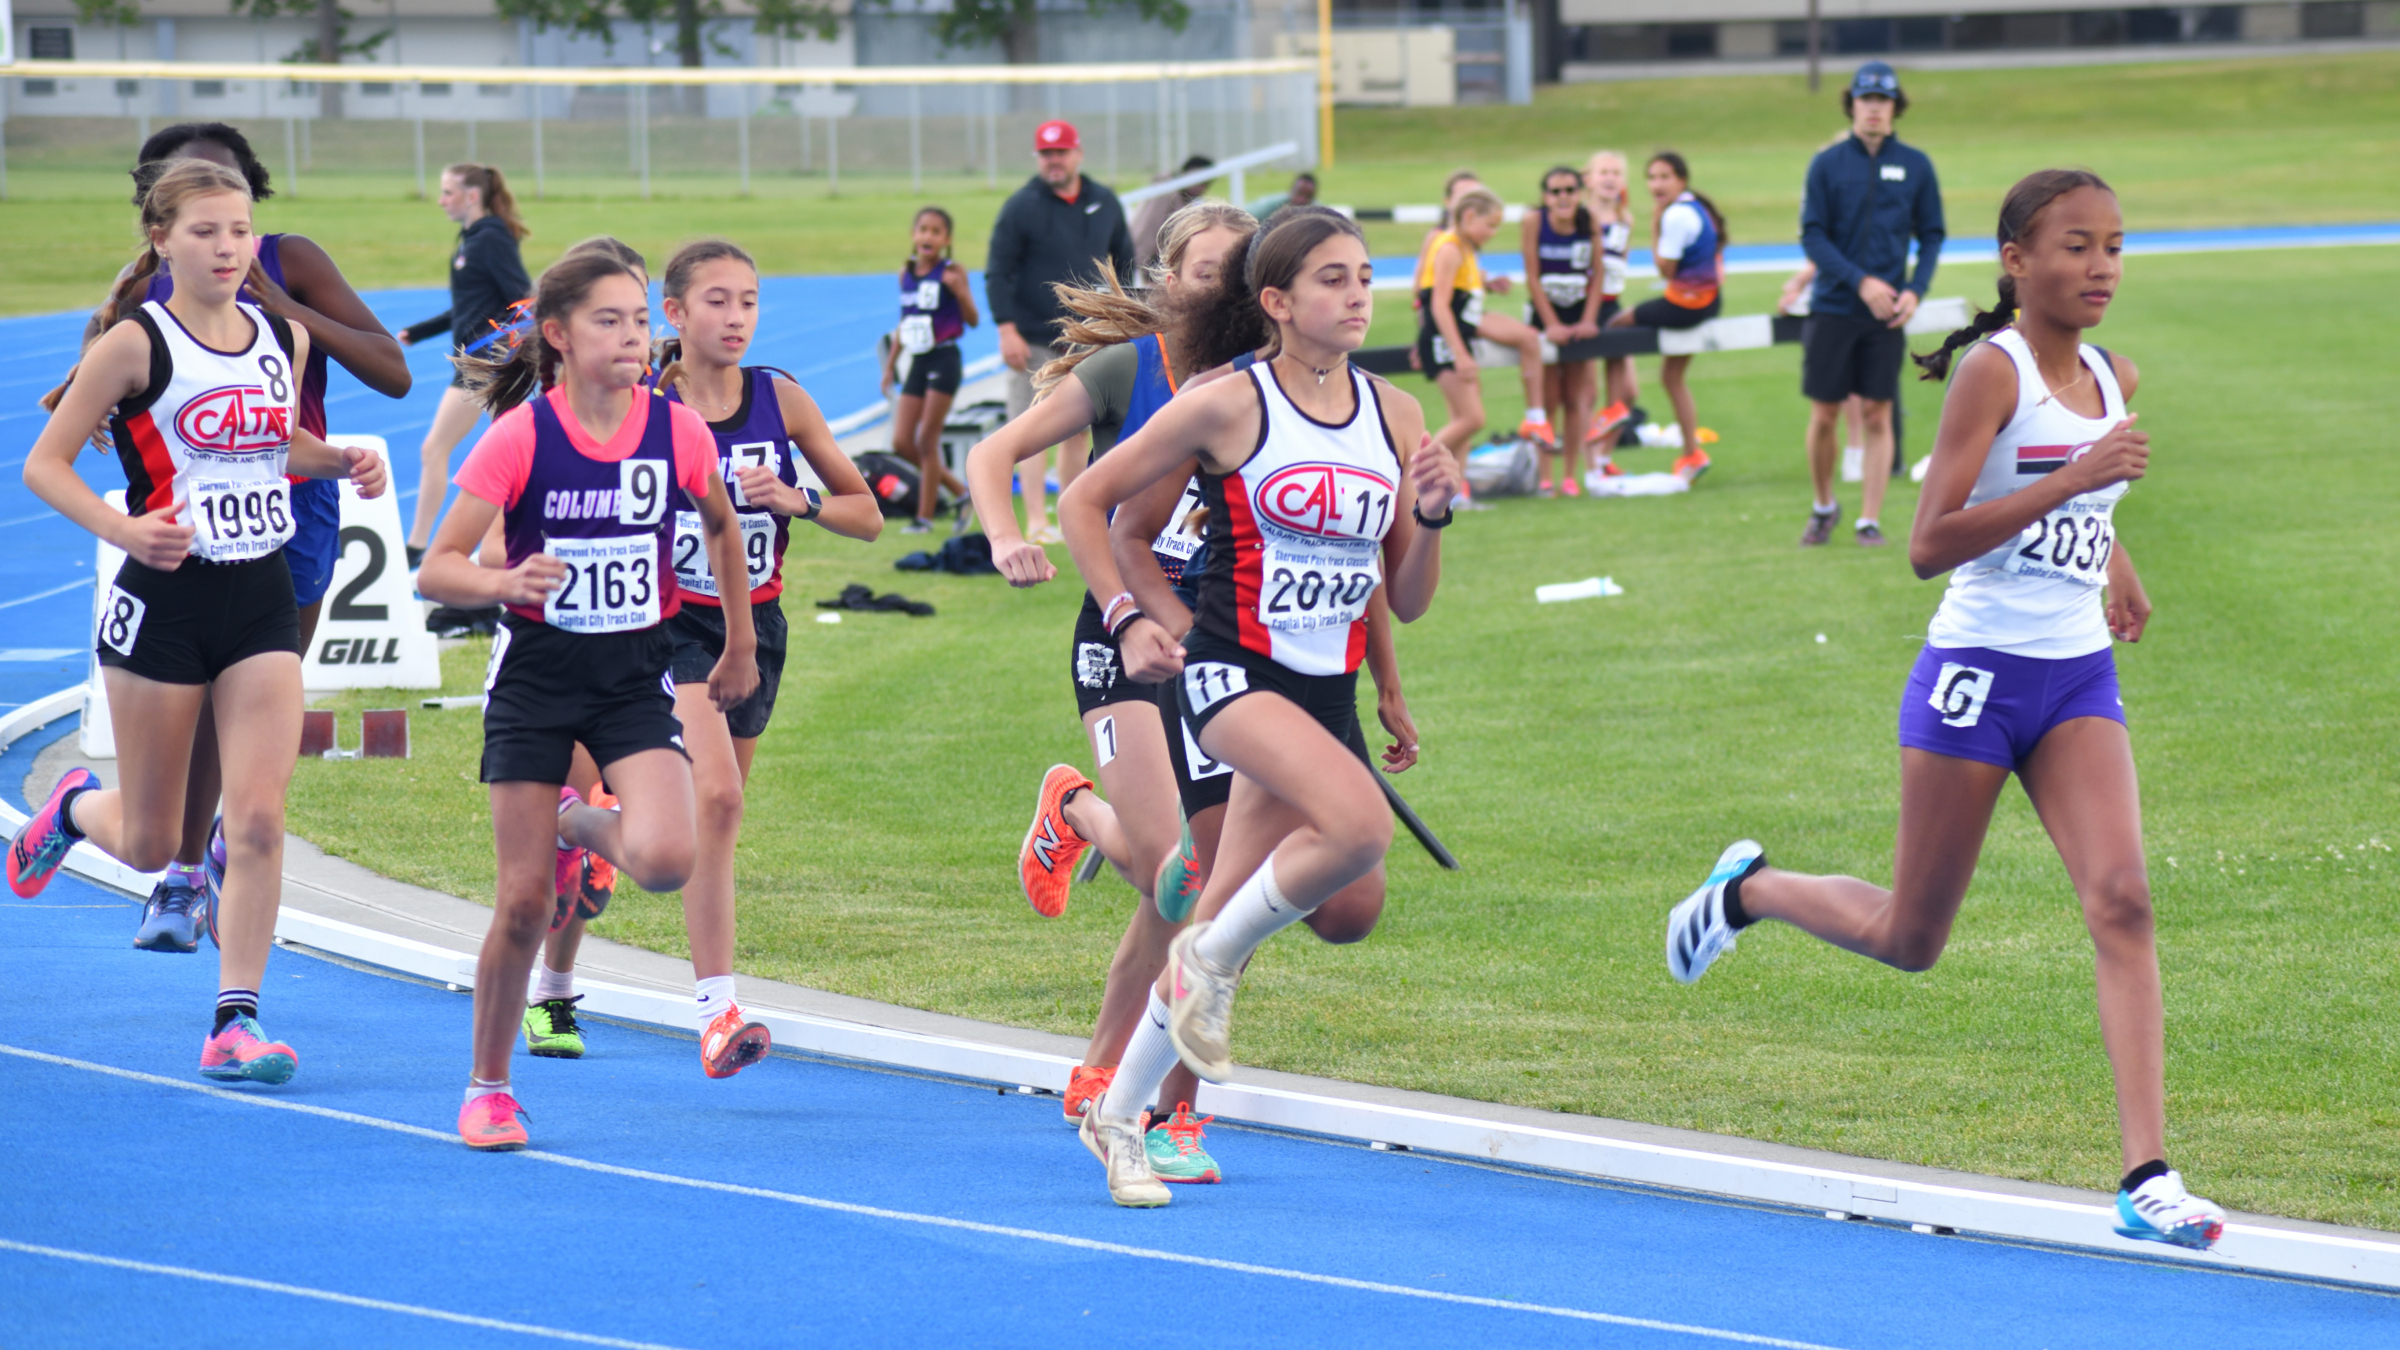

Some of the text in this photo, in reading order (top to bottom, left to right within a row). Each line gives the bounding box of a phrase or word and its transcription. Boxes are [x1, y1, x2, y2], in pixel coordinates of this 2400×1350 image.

[258, 354, 288, 403] 8
[631, 464, 658, 521] 9
[201, 489, 288, 540] 1996
[748, 518, 769, 530] Classic
[1356, 490, 1390, 538] 11
[210, 543, 234, 557] Capital
[236, 541, 249, 555] City
[251, 540, 268, 551] Track
[555, 542, 651, 558] Sherwood Park Track Classic
[1166, 536, 1185, 553] Track
[1275, 550, 1309, 565] Sherwood
[1346, 557, 1370, 568] Classic
[329, 525, 389, 621] 2
[555, 557, 651, 611] 2163
[677, 576, 702, 590] Capital
[1267, 567, 1374, 614] 2010
[109, 595, 135, 647] 8
[558, 611, 647, 629] Capital City Track Club
[1272, 617, 1300, 631] Capital
[1302, 616, 1316, 630] City
[1318, 613, 1339, 627] Track
[318, 638, 401, 665] GILL
[1196, 666, 1231, 704] 11
[1943, 670, 1979, 721] 6
[1103, 718, 1115, 757] 1
